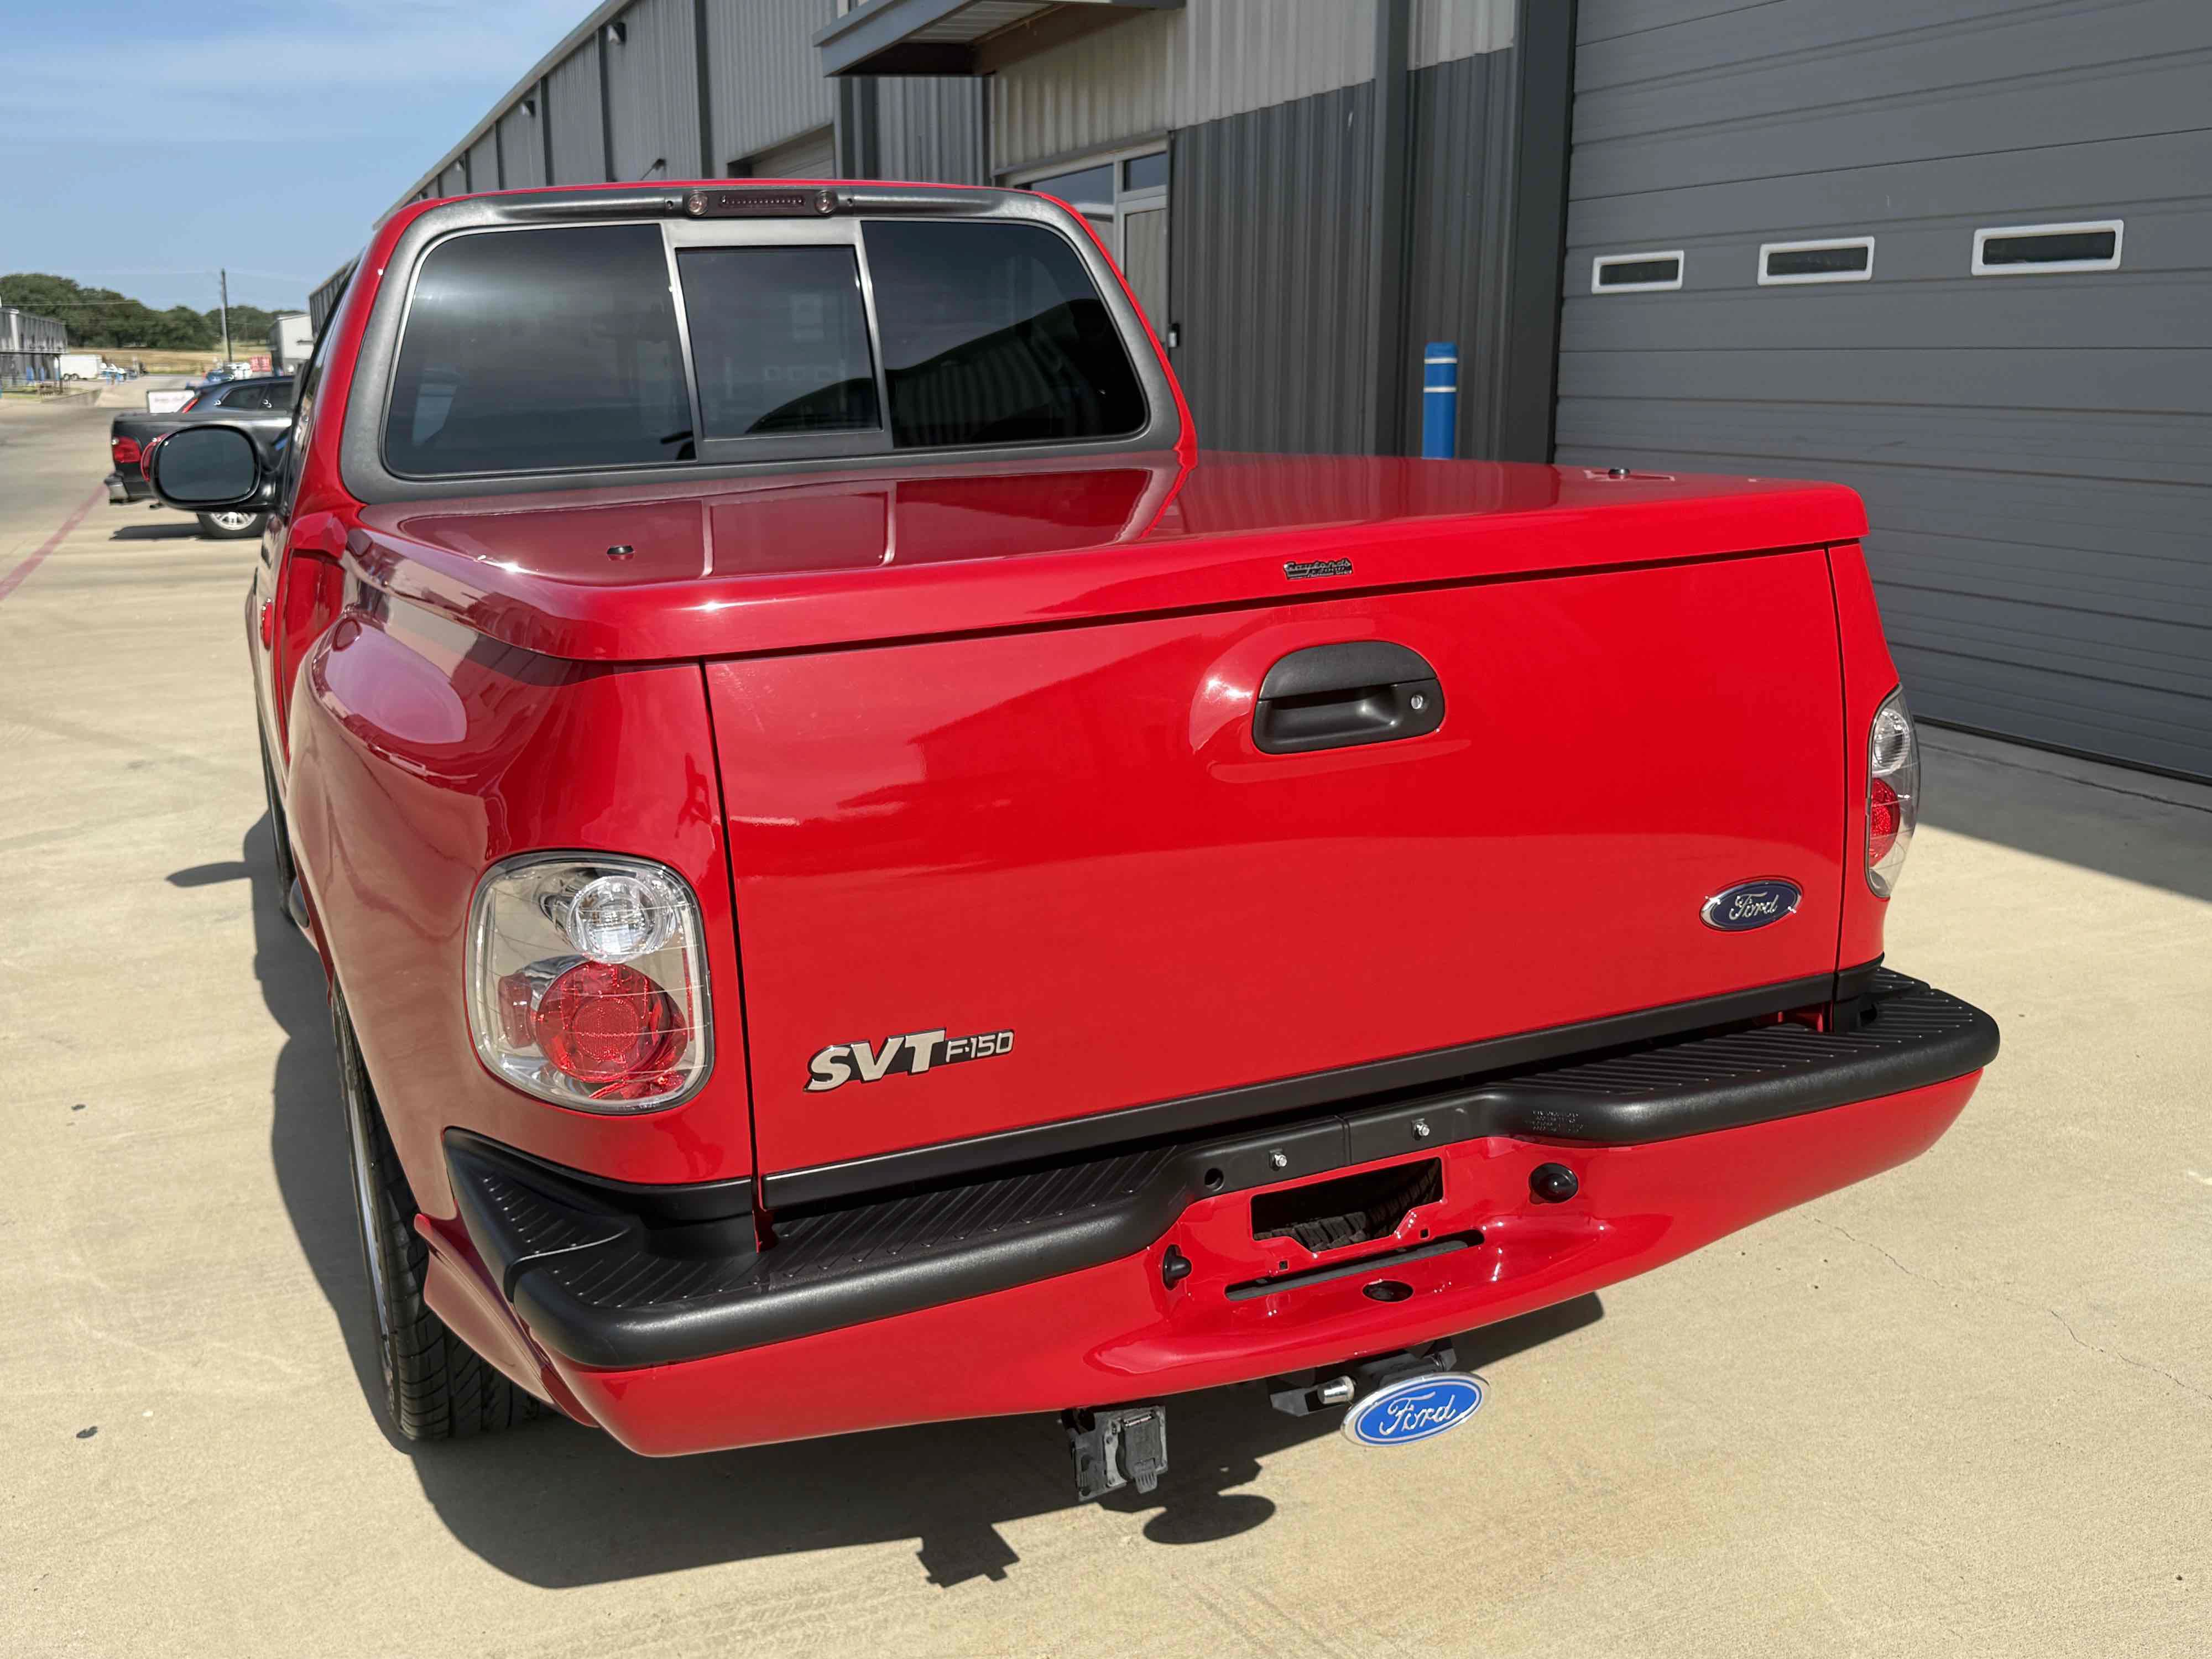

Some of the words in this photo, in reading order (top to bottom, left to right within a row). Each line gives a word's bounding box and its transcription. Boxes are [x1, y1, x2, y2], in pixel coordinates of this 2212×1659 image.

[1729, 891, 1779, 920] Ford
[804, 1028, 946, 1092] SVT
[946, 1031, 1015, 1062] F-150
[1379, 1391, 1455, 1435] Ford
